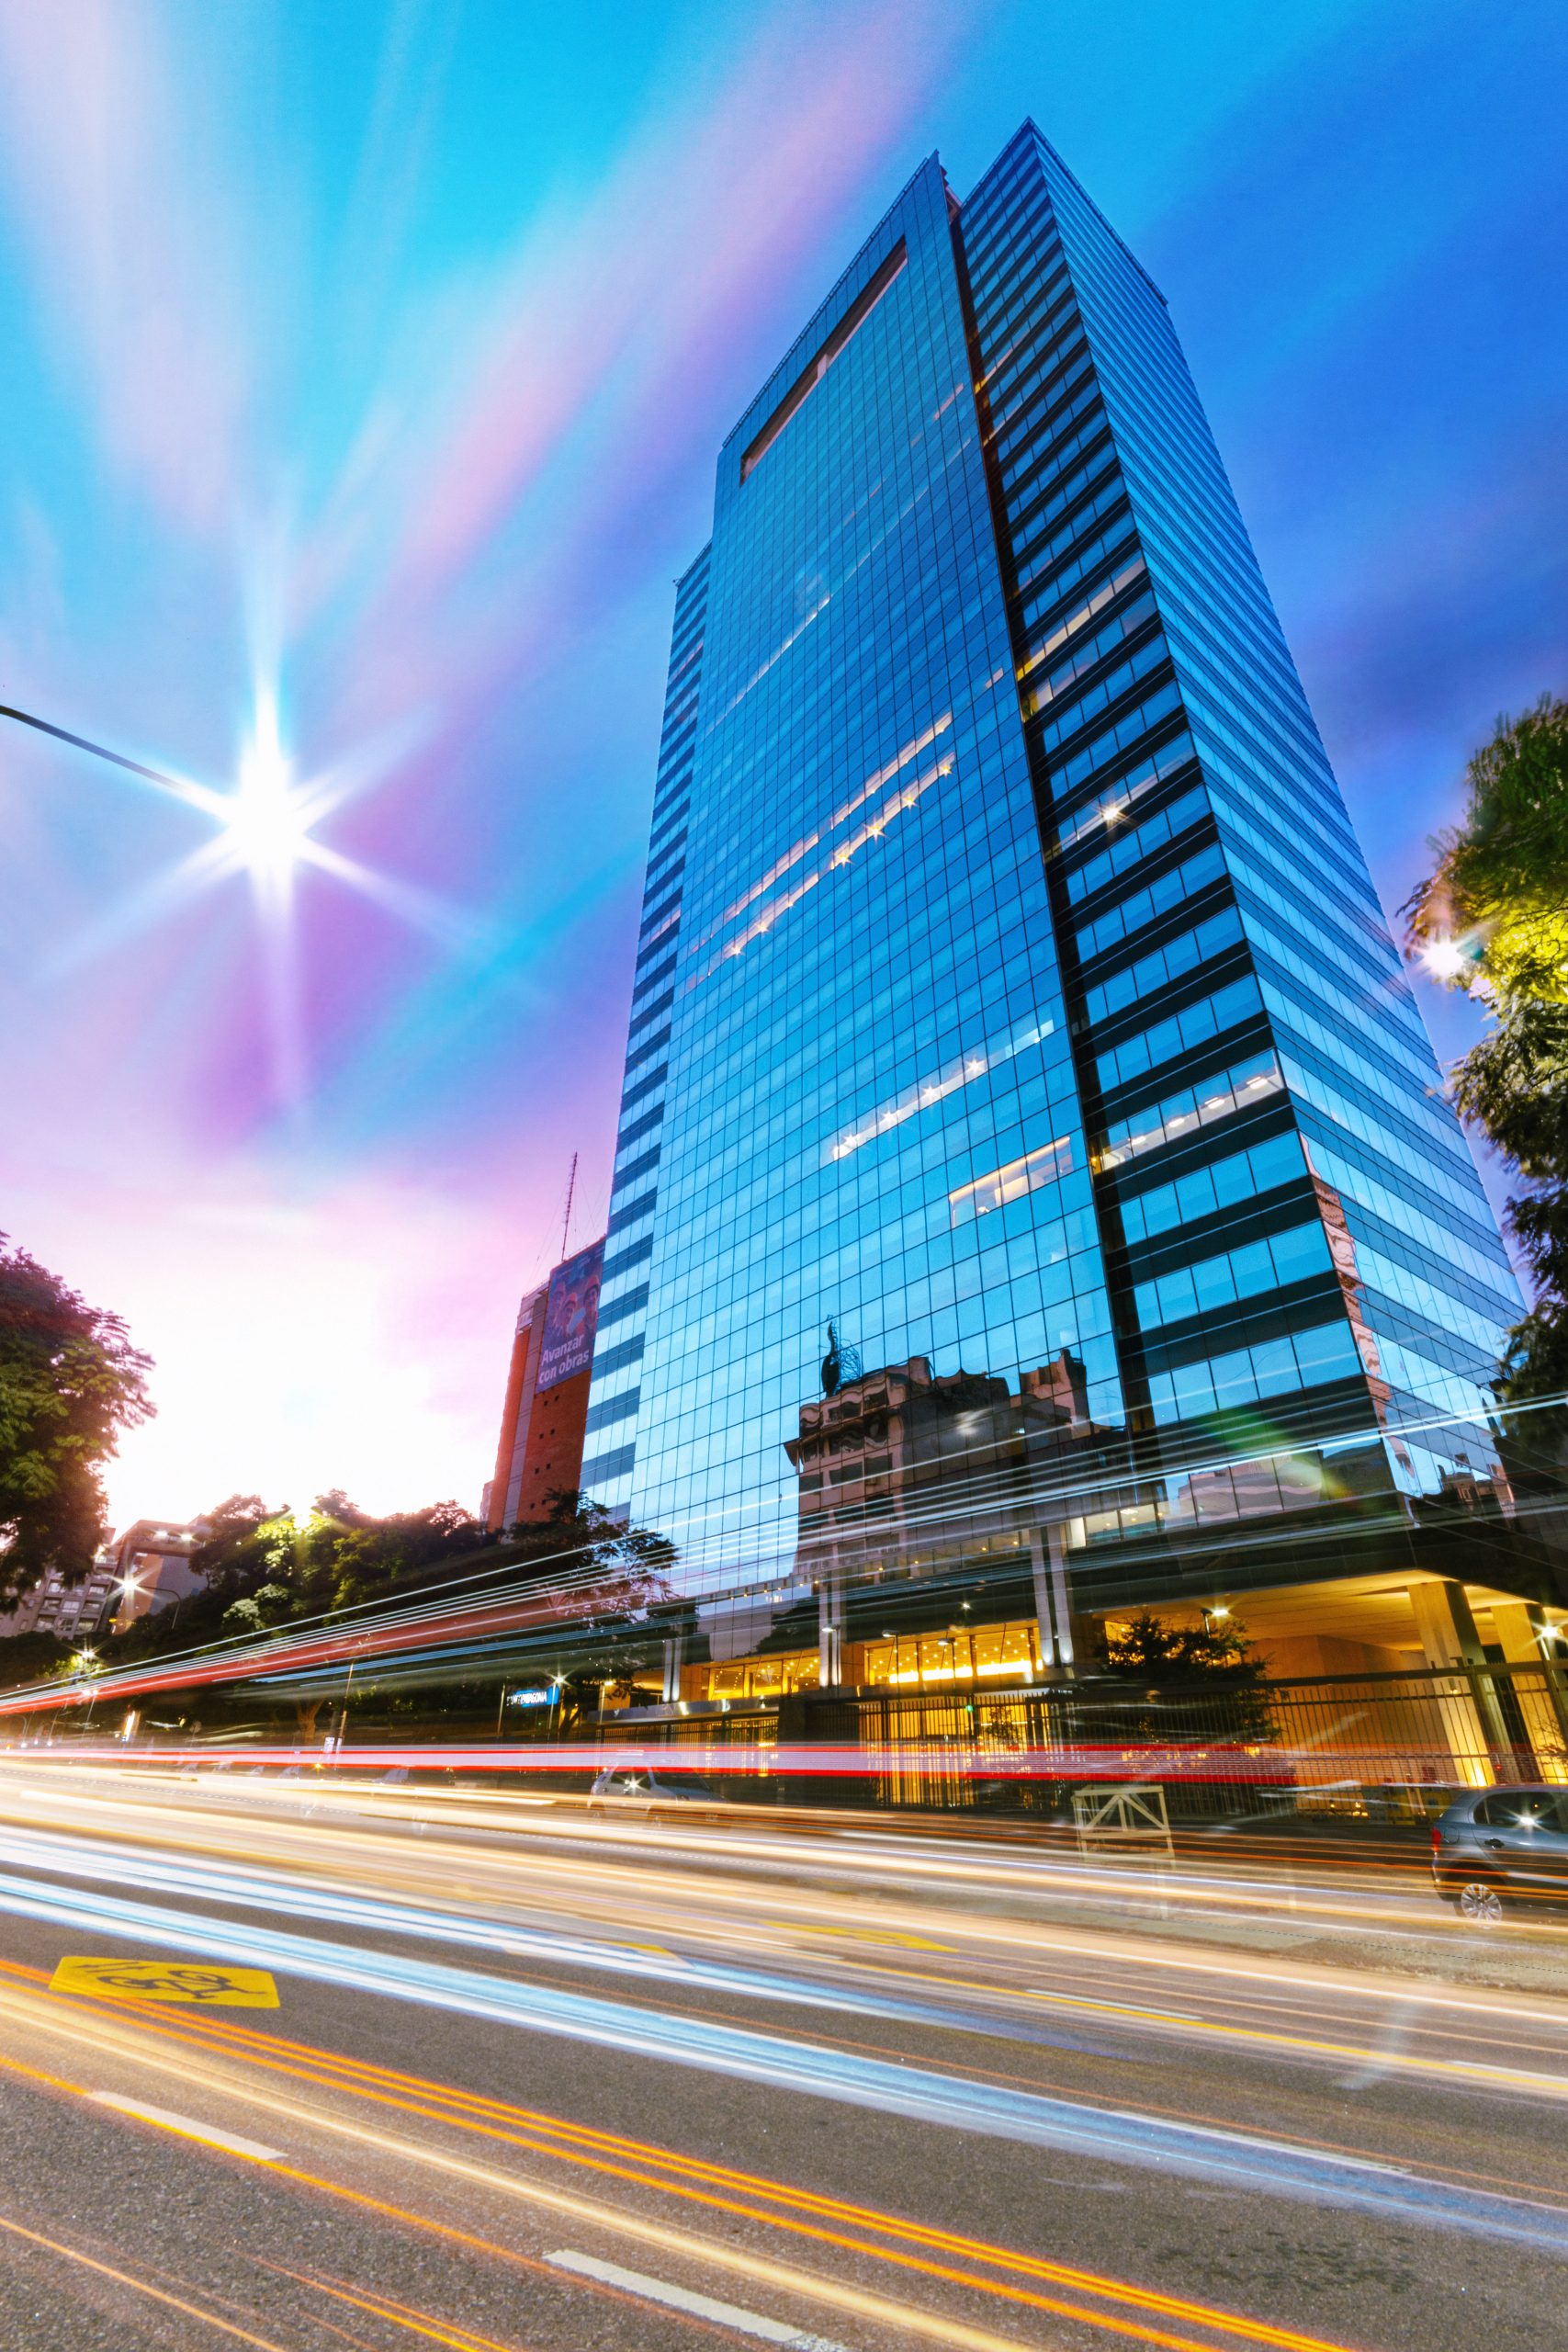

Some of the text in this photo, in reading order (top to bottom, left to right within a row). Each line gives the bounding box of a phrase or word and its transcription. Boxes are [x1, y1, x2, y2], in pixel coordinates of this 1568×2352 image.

[538, 1349, 589, 1384] con obras
[541, 1334, 584, 1366] Avanzar
